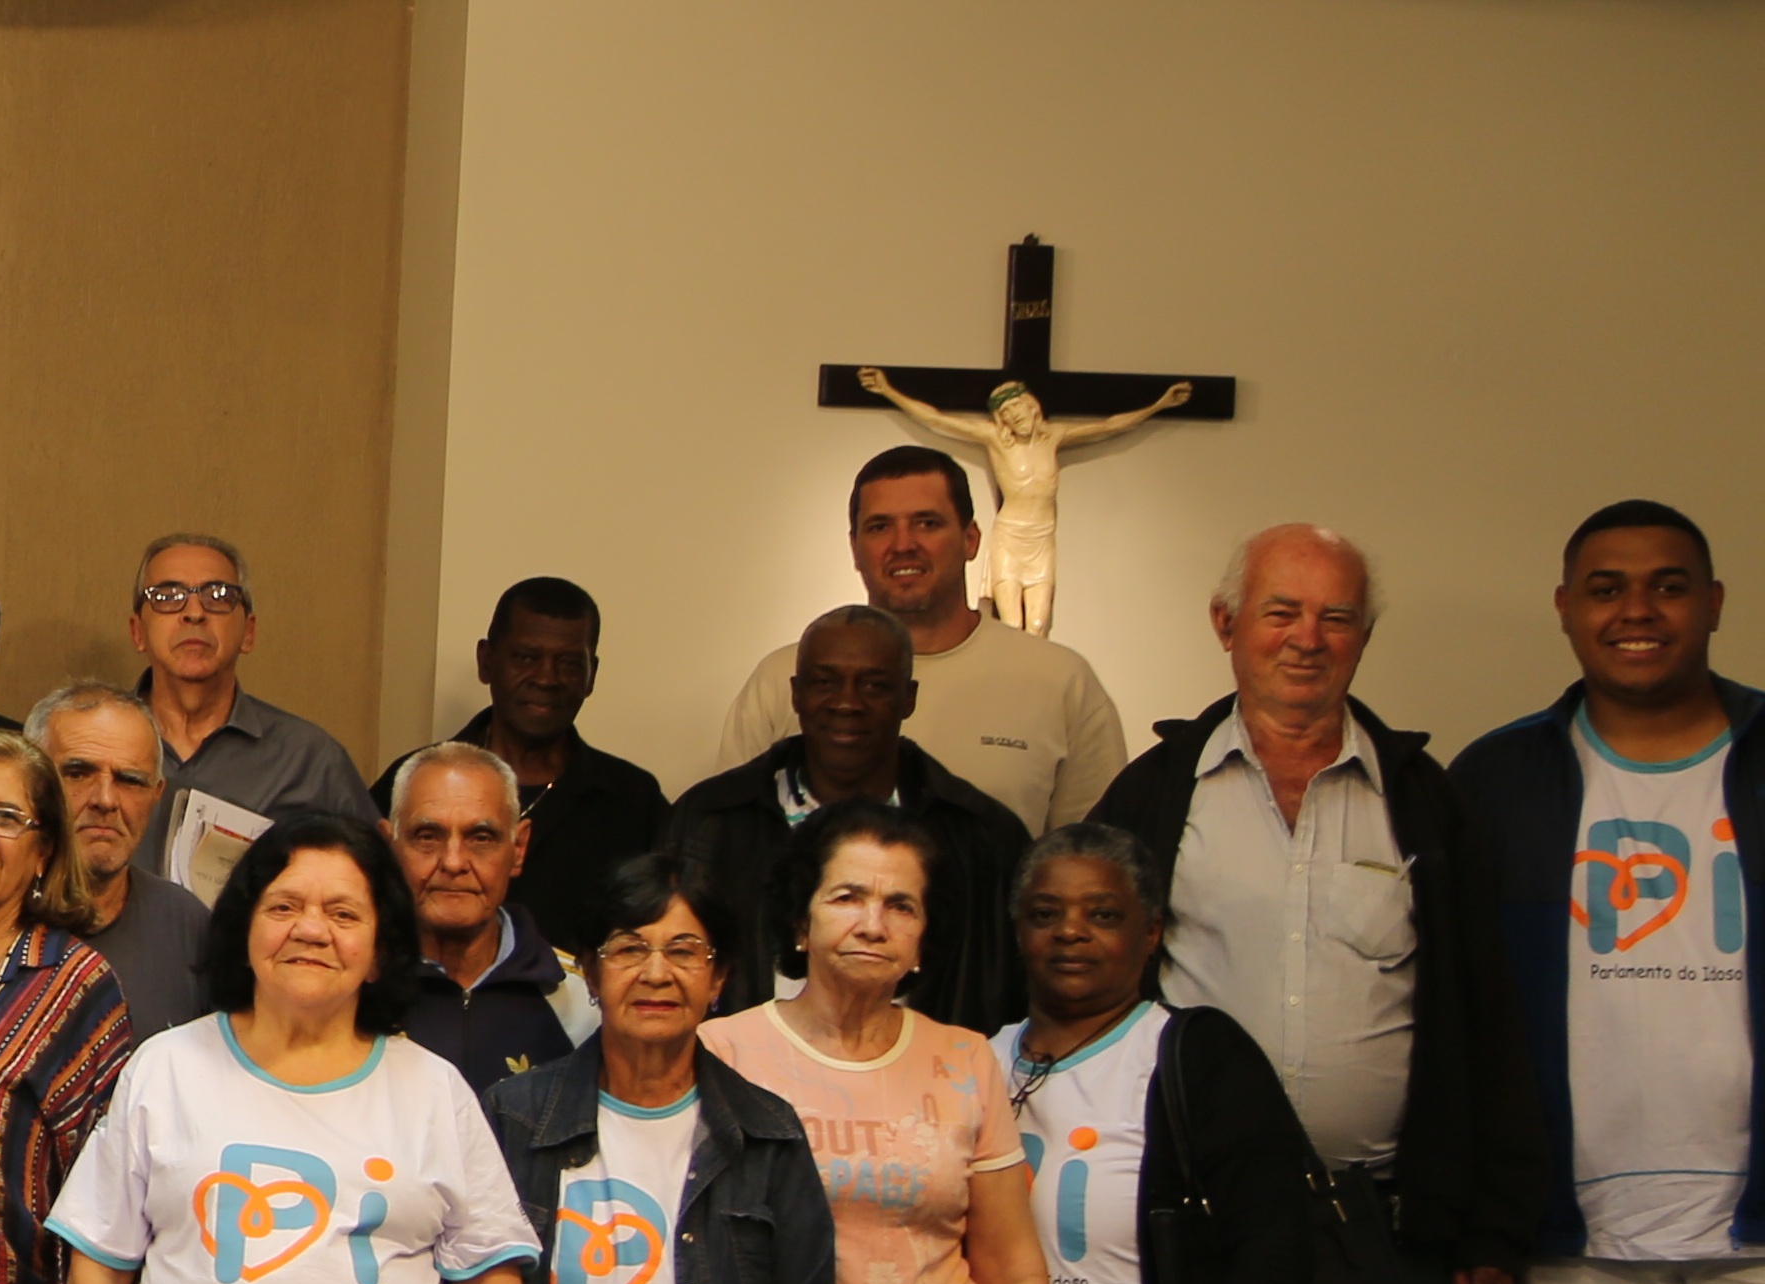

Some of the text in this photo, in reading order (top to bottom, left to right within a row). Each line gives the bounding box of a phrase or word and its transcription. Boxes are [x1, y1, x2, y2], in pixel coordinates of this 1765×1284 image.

[1590, 964, 1743, 982] Parlamento do Idoso
